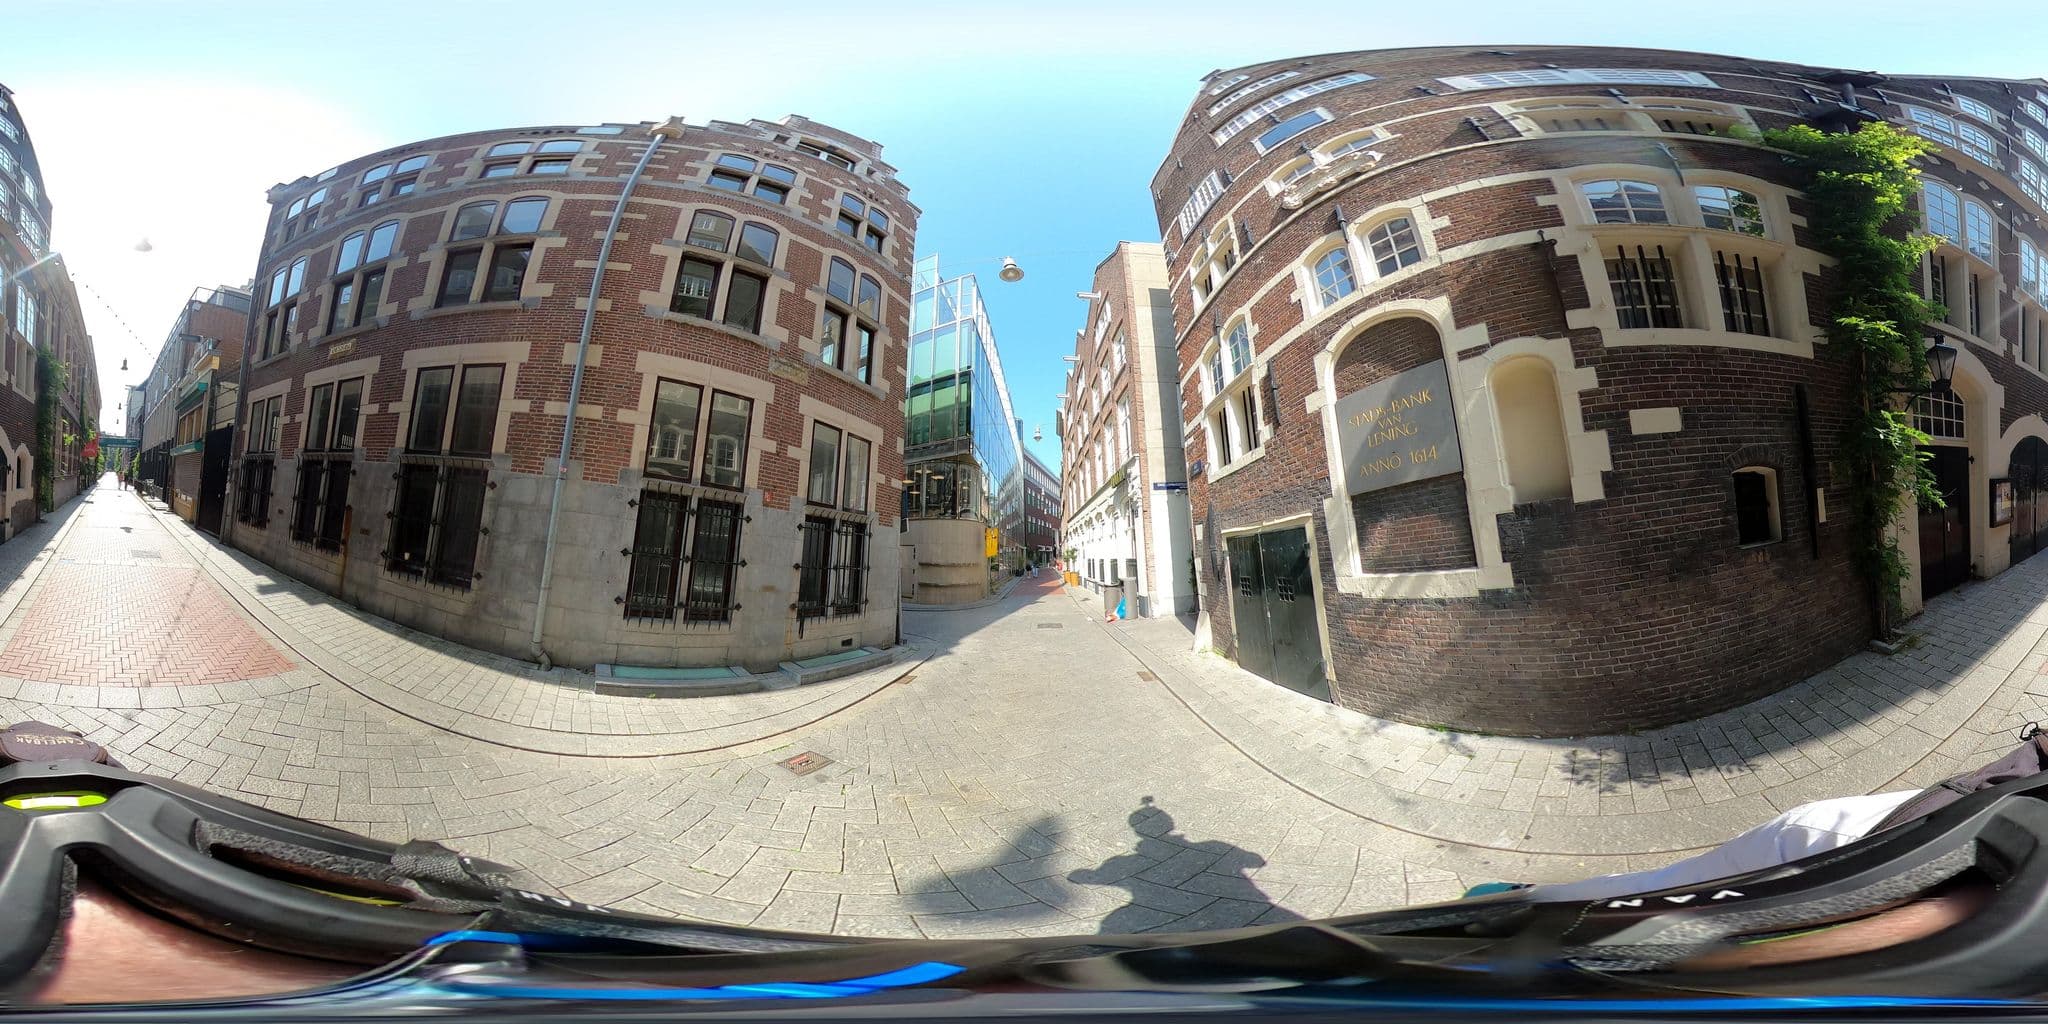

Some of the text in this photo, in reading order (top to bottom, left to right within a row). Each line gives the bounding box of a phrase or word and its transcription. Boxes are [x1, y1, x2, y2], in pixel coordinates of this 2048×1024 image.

[1377, 413, 1402, 429] VAN
[1367, 422, 1417, 448] LENING
[1360, 444, 1439, 478] ANNO 1614
[15, 736, 84, 746] CAMELBAK
